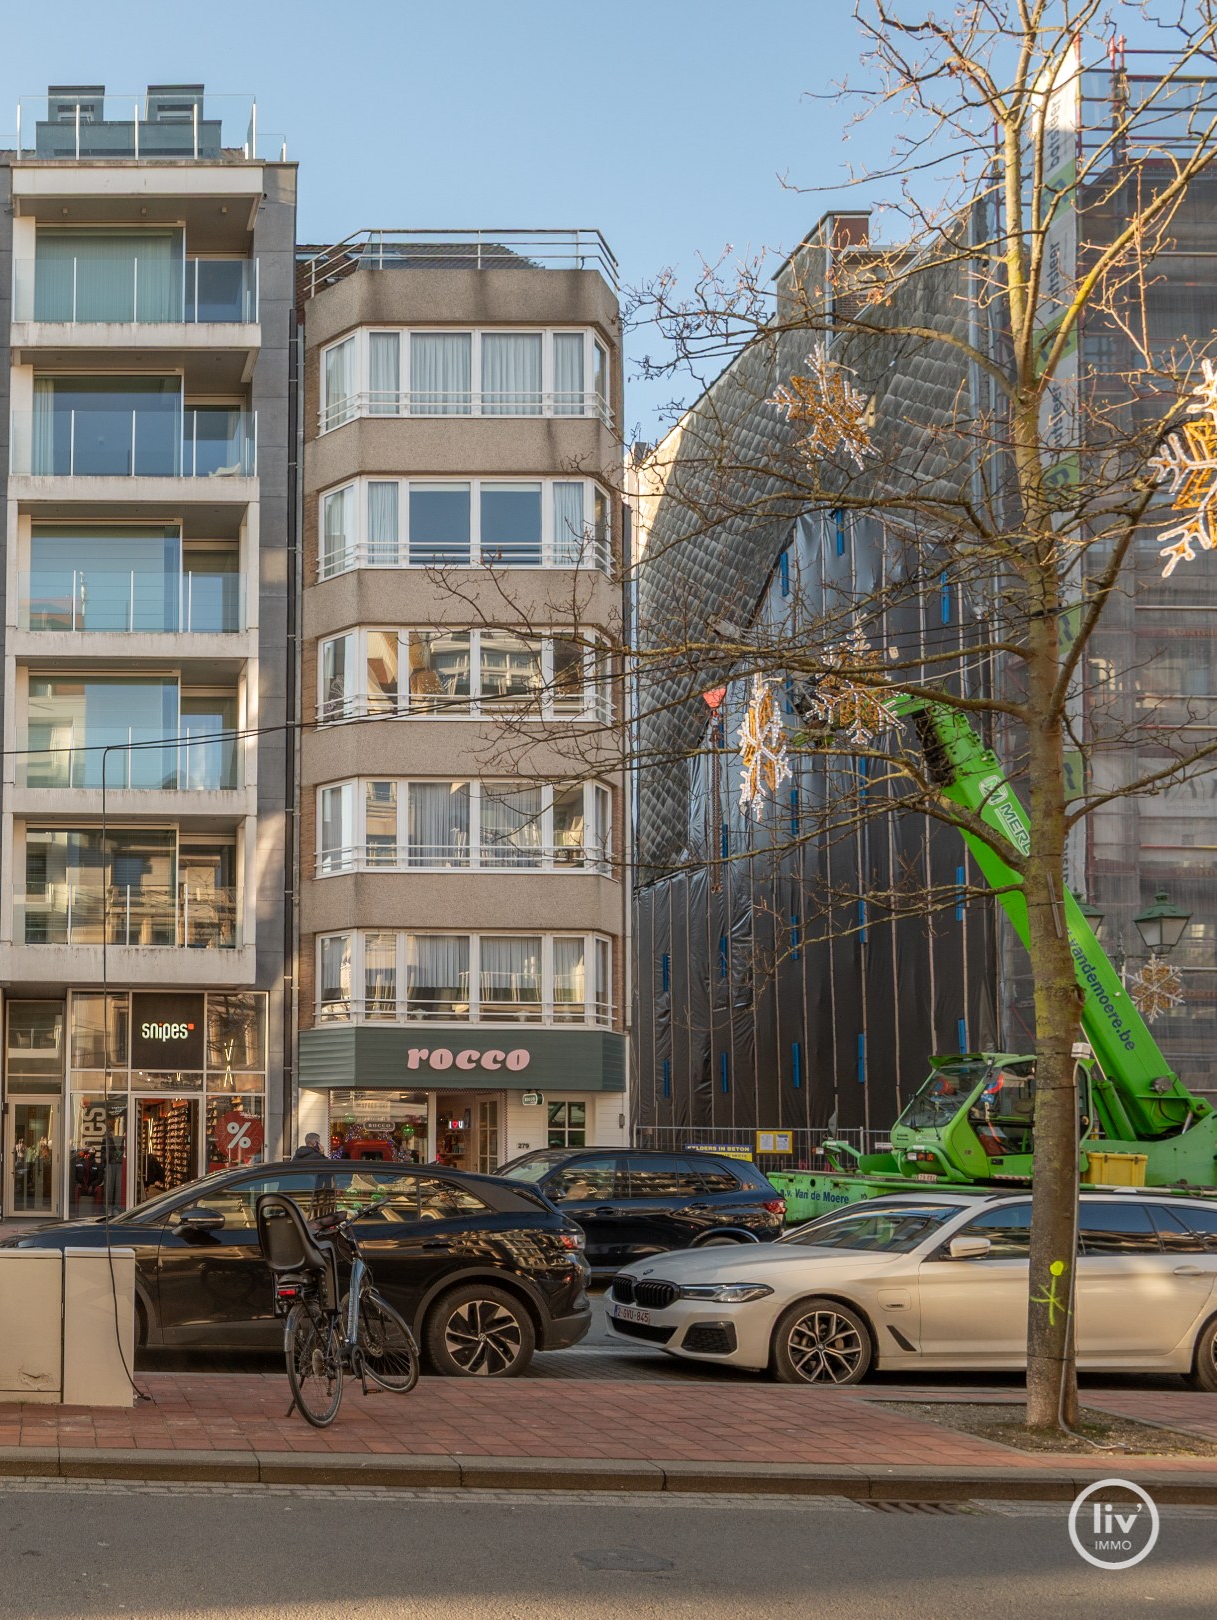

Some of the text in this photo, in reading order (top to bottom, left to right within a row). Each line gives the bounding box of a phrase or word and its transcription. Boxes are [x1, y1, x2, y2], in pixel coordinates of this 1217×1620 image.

[1000, 803, 1030, 855] MERL
[1068, 937, 1135, 1051] vandemoere.be
[141, 1022, 189, 1042] snipes
[406, 1048, 530, 1071] rocco
[795, 1188, 809, 1199] Van
[810, 1190, 821, 1201] de
[823, 1191, 850, 1204] Moere
